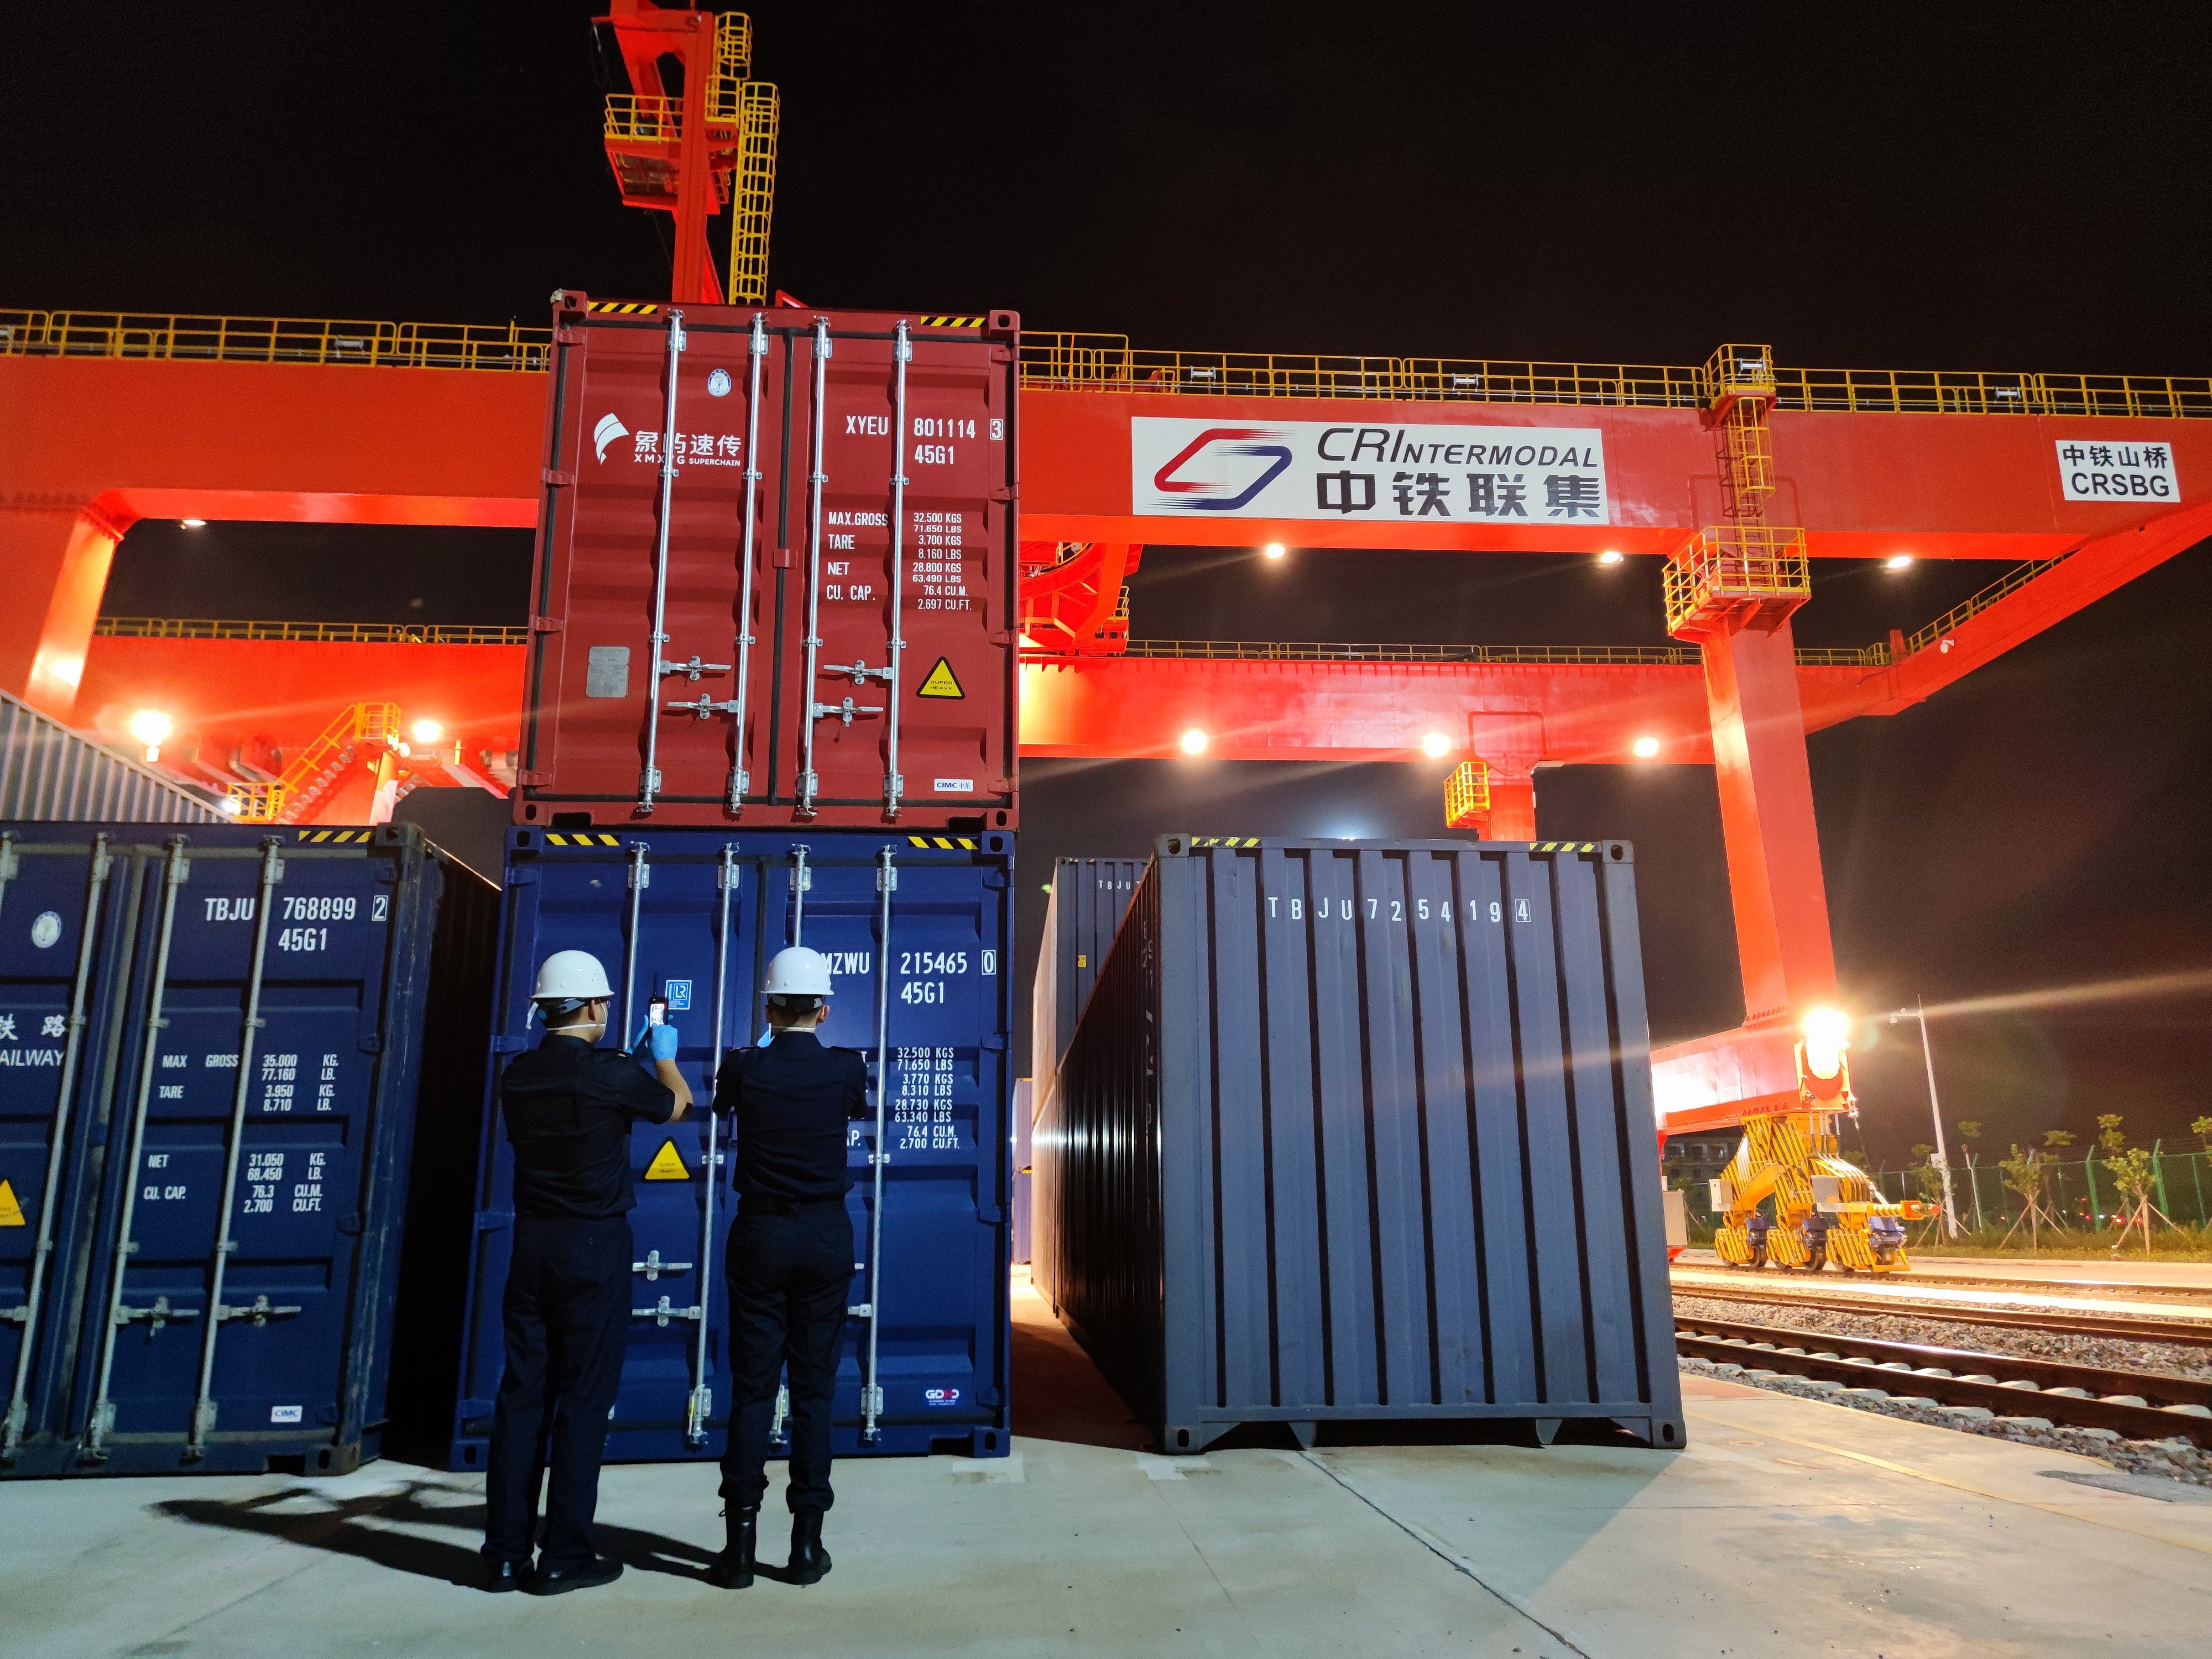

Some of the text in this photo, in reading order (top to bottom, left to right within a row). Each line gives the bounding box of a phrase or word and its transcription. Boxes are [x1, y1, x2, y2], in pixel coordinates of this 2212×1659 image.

[846, 415, 1002, 439] XYEU 801114 3
[634, 453, 740, 466] XMXG SUPERCHAIN
[914, 445, 954, 465] 45G1
[2062, 444, 2167, 468] 中铁山桥
[2072, 472, 2169, 497] CRSBG
[1316, 470, 1600, 519] 中铁联集
[828, 512, 962, 526] MAX.GROSS 32,500 KGS
[828, 534, 855, 550] TARE
[945, 535, 962, 545] KGS
[945, 549, 962, 560] LBS
[827, 562, 850, 575] NET
[945, 563, 962, 573] KGS
[826, 585, 968, 601] CU. CAP. 76.4 CU.M.
[918, 598, 972, 611] 2,697 CU.FT.
[205, 896, 386, 921] TBJU 768899 2
[278, 927, 327, 951] 45G1
[900, 952, 967, 974] 215465
[675, 985, 686, 998] LR
[901, 982, 945, 1004] 45G1
[936, 1047, 954, 1058] KGS
[162, 1055, 188, 1068] MAX
[205, 1054, 240, 1068] GROSS
[322, 1053, 339, 1067] KG.
[898, 1058, 953, 1071] 71,650 LBS
[321, 1067, 336, 1081] LB.
[935, 1073, 953, 1084] KGS
[159, 1086, 185, 1099] TARE
[319, 1084, 335, 1097] KG.
[934, 1084, 952, 1096] LBS
[317, 1098, 332, 1111] LB.
[933, 1098, 952, 1111] KGS
[933, 1111, 951, 1123] LBS
[907, 1125, 957, 1138] 76.4 CU.M.
[900, 1138, 960, 1150] 2,700 CU.FT.
[148, 1154, 170, 1168] NET
[309, 1152, 326, 1166] KG.
[307, 1166, 324, 1181] LB.
[143, 1186, 161, 1200] CU.
[164, 1186, 187, 1200] CAP.
[252, 1185, 275, 1198] 76.3
